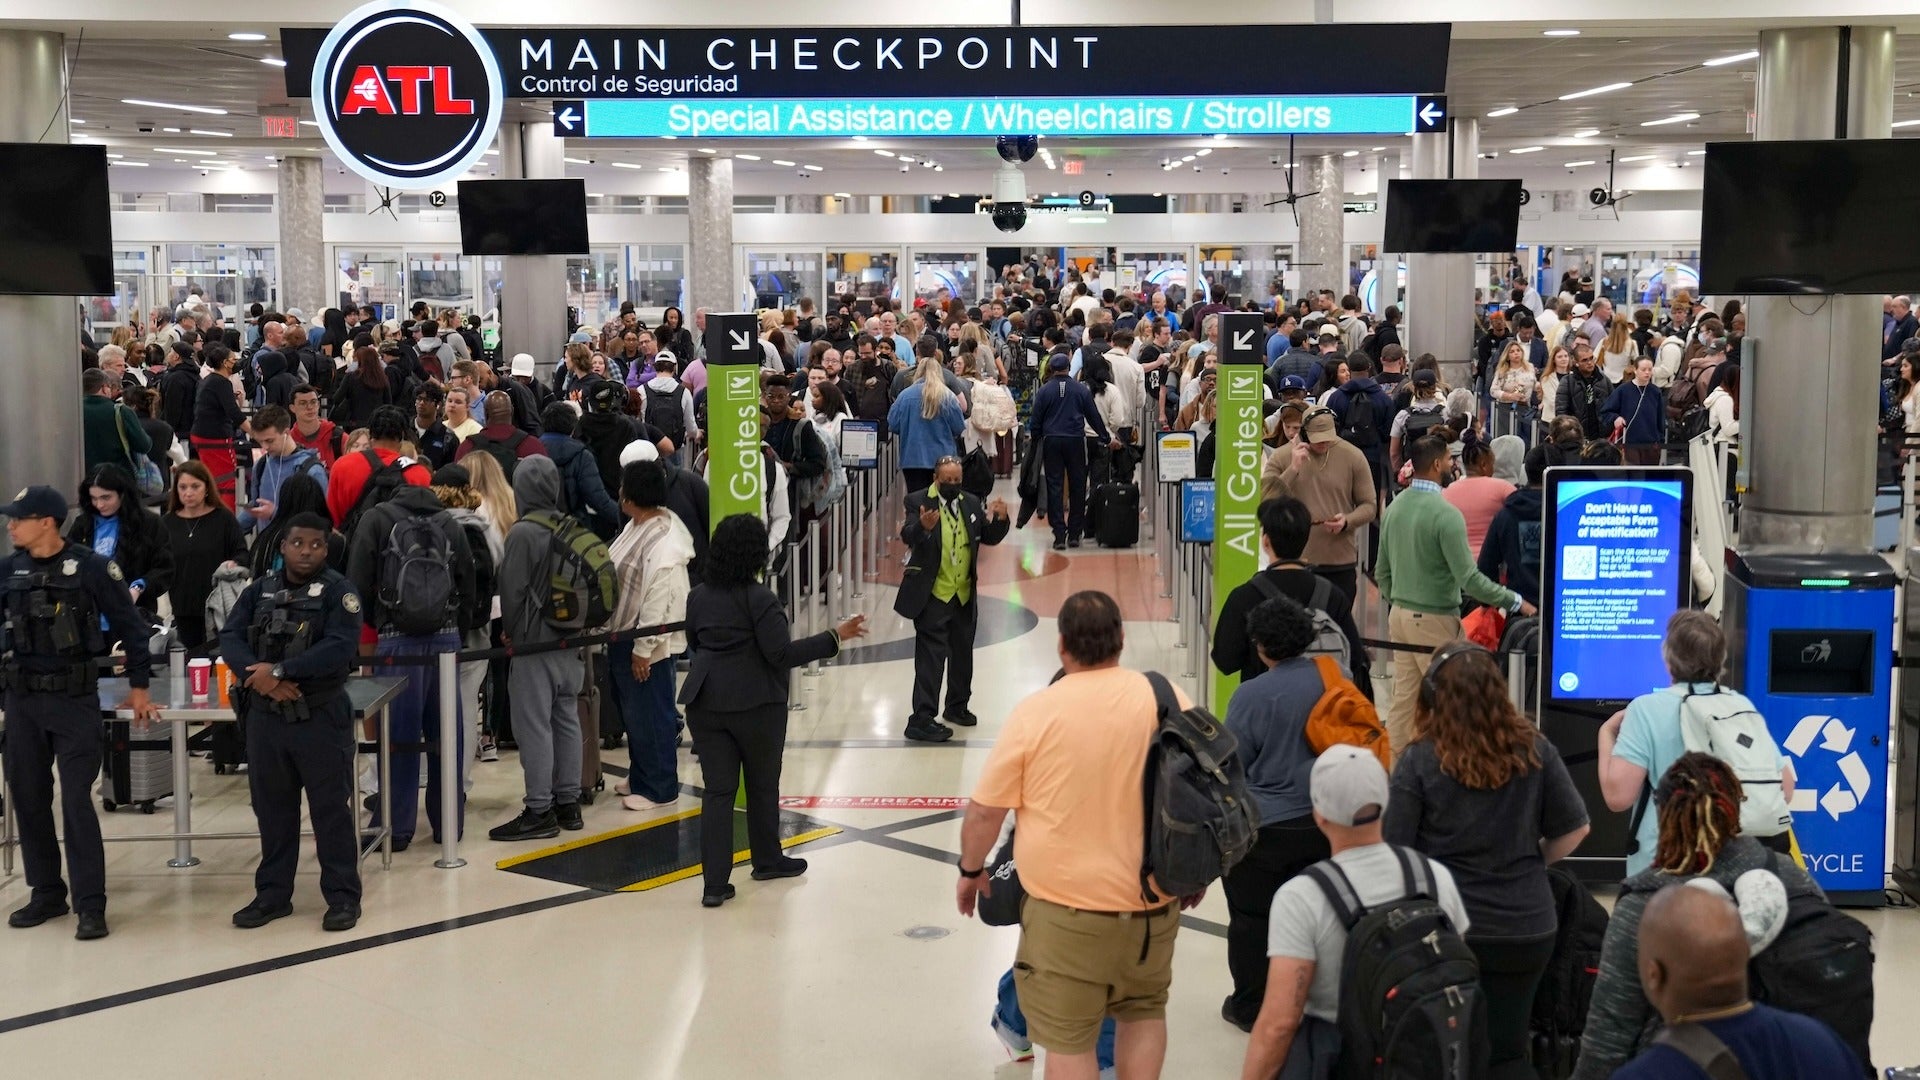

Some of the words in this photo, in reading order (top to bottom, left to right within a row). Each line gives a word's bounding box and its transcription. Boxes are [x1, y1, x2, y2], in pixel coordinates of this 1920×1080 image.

[521, 38, 666, 71] MAIN
[706, 37, 1098, 70] CHECKPOINT
[341, 65, 474, 115] ATL
[521, 75, 597, 93] Control
[603, 75, 629, 92] de
[635, 75, 738, 95] Seguridad
[668, 104, 779, 136] Special
[788, 103, 952, 132] Assistance
[961, 103, 973, 132] /
[982, 102, 1173, 131] Wheelchairs
[1182, 102, 1193, 130] /
[1203, 101, 1332, 130] Strollers
[430, 192, 445, 205] 12
[1082, 193, 1092, 204] 9
[1593, 190, 1604, 203] 7
[730, 405, 758, 501] Gates
[1226, 405, 1258, 502] Gates
[1585, 503, 1612, 514] Don't
[1612, 503, 1638, 514] Have
[1639, 504, 1653, 514] an
[1578, 515, 1632, 527] Acceptable
[1632, 515, 1658, 526] Form
[1223, 514, 1256, 556] All
[1577, 527, 1589, 538] of
[1589, 527, 1659, 538] Identification?
[1600, 548, 1614, 556] Scan
[1614, 548, 1625, 556] the
[1635, 548, 1650, 556] code
[1802, 854, 1864, 873] YCLE
